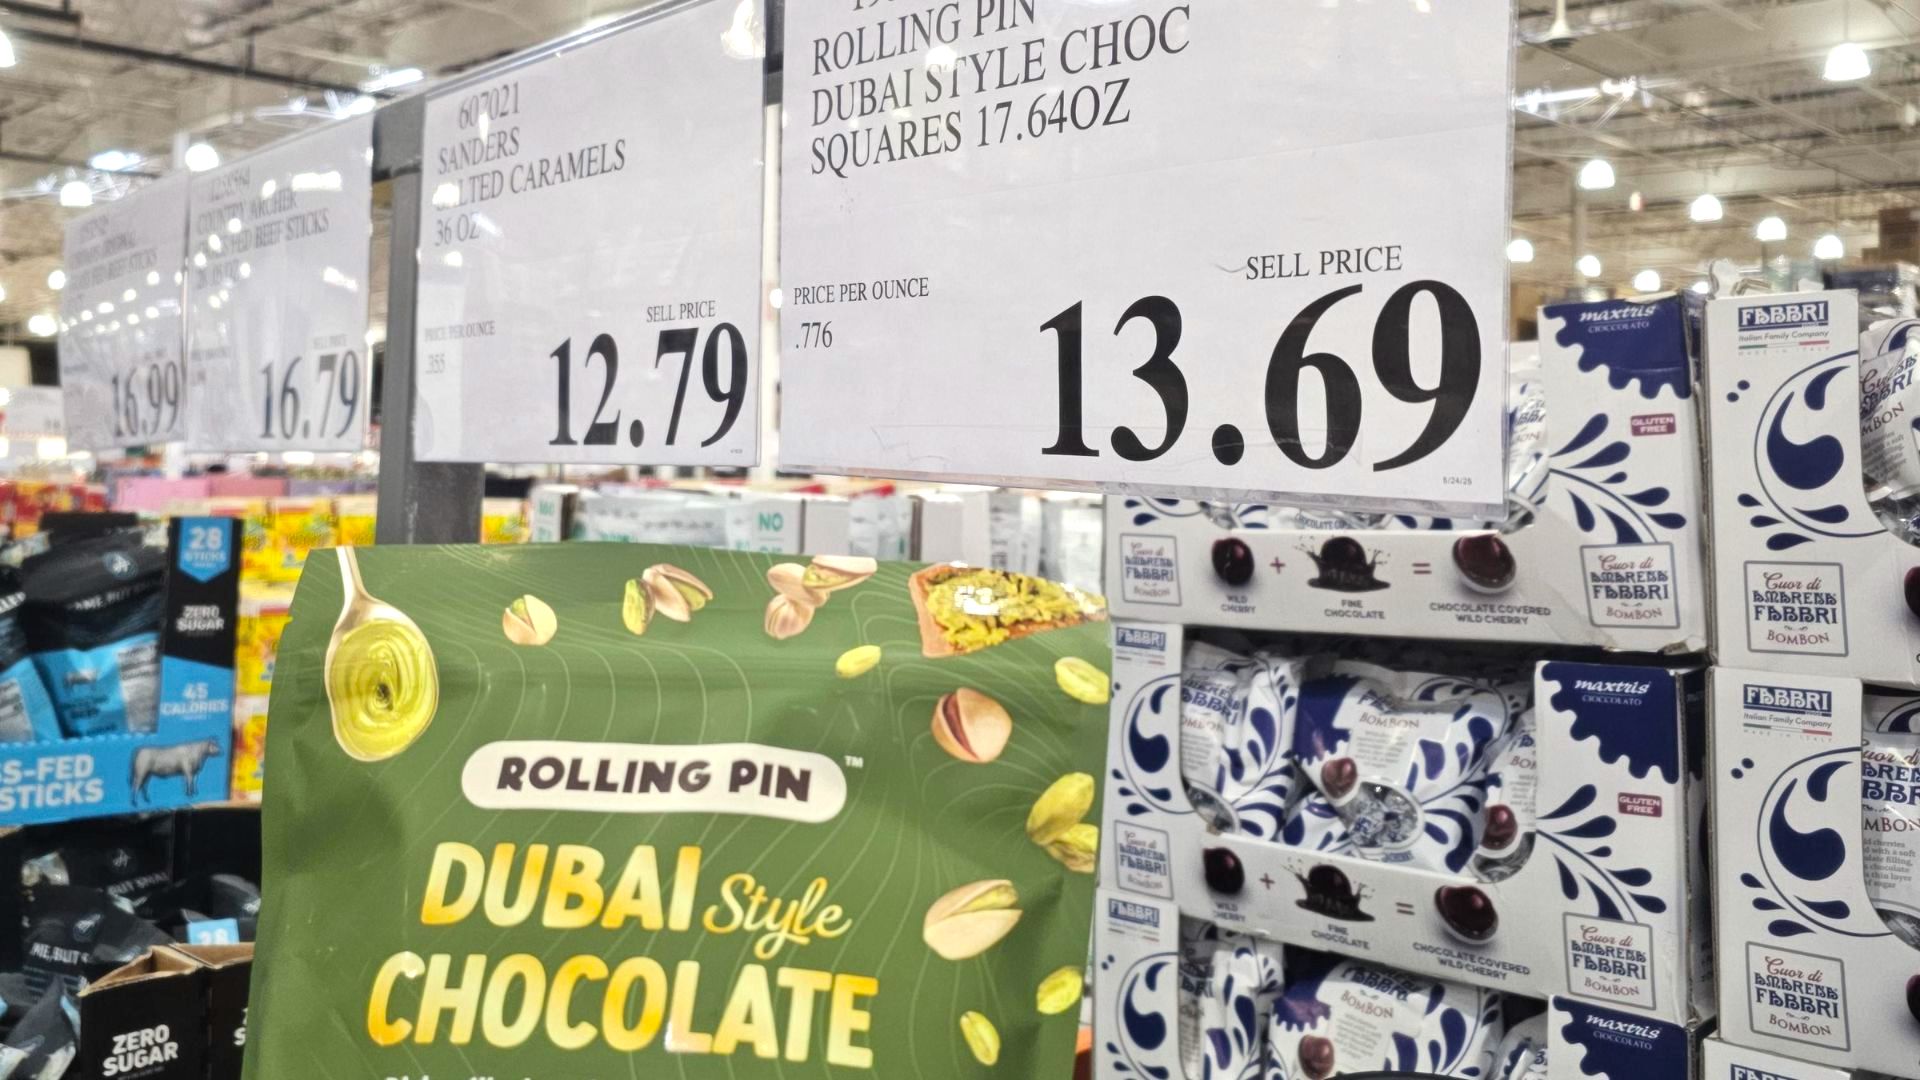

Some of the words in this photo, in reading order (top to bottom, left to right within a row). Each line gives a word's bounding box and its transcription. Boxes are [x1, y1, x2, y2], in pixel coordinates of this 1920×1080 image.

[812, 3, 962, 76] ROLLING
[973, 0, 1035, 37] PIN
[811, 69, 912, 126] DUBAI
[925, 38, 1046, 103] STYLE
[1060, 4, 1190, 75] CHOC
[458, 81, 520, 130] 607021
[811, 110, 962, 178] SQUARES
[977, 78, 1130, 147] 17.64OZ
[438, 126, 520, 175] SANDERS
[437, 169, 504, 211] LTED
[510, 138, 626, 194] CARAMELS
[1246, 252, 1309, 281] SELL
[1319, 245, 1403, 275] PRICE
[794, 285, 835, 305] PRICE
[839, 281, 868, 303] PER
[871, 277, 930, 301] OUNCE
[646, 304, 675, 323] SELL
[680, 300, 716, 319] PRICE
[1579, 304, 1656, 321] maxtris
[1740, 303, 1826, 326] FABBRI
[466, 320, 496, 337] OUNCE
[795, 320, 832, 348] .776
[1738, 333, 1763, 342] Italian
[1764, 332, 1789, 342] Family
[1791, 330, 1830, 340] Company
[549, 321, 748, 449] 12.79
[1040, 279, 1482, 472] 13.69
[112, 360, 179, 438] 16.99
[259, 350, 360, 440] 16.79
[1631, 416, 1674, 426] GLUTEN
[1639, 424, 1668, 434] FREE
[189, 527, 222, 549] 28
[1597, 554, 1639, 571] Cuor
[1641, 556, 1654, 568] di
[1762, 571, 1803, 591] Cuor
[1805, 576, 1822, 589] di
[1592, 583, 1669, 601] FABBRI
[183, 605, 220, 618] ZERO
[1221, 604, 1256, 614] CHERRY
[1324, 608, 1386, 620] CHOCOLATE
[1341, 599, 1363, 609] FINE
[1429, 601, 1497, 615] CHOCOLATE
[1498, 604, 1552, 616] COVERED
[1605, 605, 1664, 621] BOMBON
[1753, 604, 1838, 625] FABBRI
[177, 618, 224, 632] SUGAR
[1455, 613, 1484, 624] WILD
[1485, 614, 1530, 626] CHERRY
[1766, 629, 1830, 646] BOMBON
[1575, 679, 1651, 694] maxtris
[161, 699, 229, 717] CALORIES
[1582, 694, 1643, 706] CIOCCOLATO
[1746, 686, 1829, 710] FABBRI
[1360, 711, 1420, 729] BOMBON
[1743, 712, 1767, 721] Italian
[1769, 714, 1794, 725] Family
[1795, 717, 1833, 728] Company
[495, 757, 712, 794] ROLLING
[728, 759, 812, 803] PIN
[0, 777, 105, 812] STICKS
[1619, 796, 1661, 807] GLUTEN
[1626, 804, 1655, 815] FREE
[420, 841, 702, 932] DUBAI
[703, 873, 852, 960] Style
[1216, 902, 1238, 911] WILD
[1311, 930, 1371, 950] CHOCOLATE
[1327, 924, 1349, 936] FINE
[1580, 925, 1617, 944] Cuor
[1618, 933, 1633, 946] di
[1412, 942, 1477, 963] CHOCOLATE
[1478, 956, 1531, 975] COVERED
[1437, 957, 1464, 970] WILD
[1464, 963, 1508, 980] CHERRY
[1572, 953, 1647, 980] FABBRI
[1764, 956, 1805, 978] Cuor
[1807, 969, 1823, 982] di
[1584, 977, 1640, 996] BOMBON
[367, 950, 879, 1069] CHOCOLATE
[1340, 989, 1394, 1018] BOMBON
[1755, 987, 1839, 1019] FABBRI
[1586, 1013, 1662, 1040] maxtris
[1768, 1013, 1833, 1036] BOMBON
[112, 1023, 170, 1055] ZERO
[1592, 1030, 1653, 1050] CIOCCOLATO
[103, 1041, 179, 1077] SUGAR
